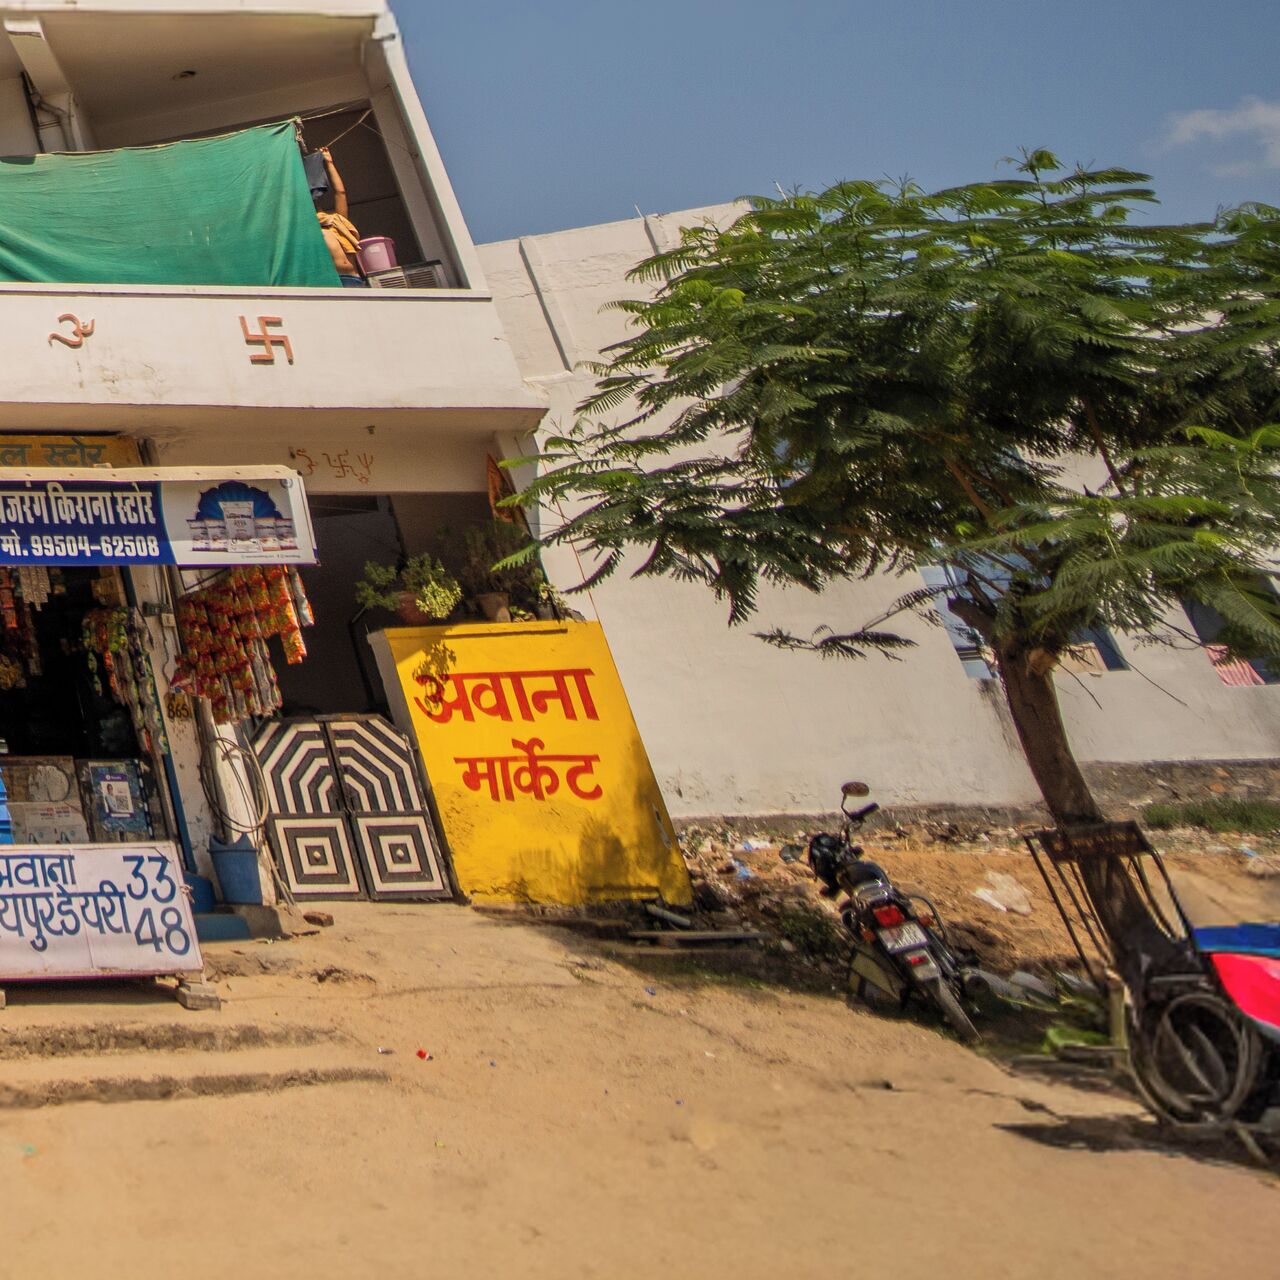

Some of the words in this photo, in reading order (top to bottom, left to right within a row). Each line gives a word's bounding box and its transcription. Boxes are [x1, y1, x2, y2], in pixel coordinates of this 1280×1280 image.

[41, 436, 107, 466] स्टोर
[48, 482, 112, 525] किराना
[111, 483, 156, 525] स्टोर
[0, 530, 28, 557] मो.
[32, 534, 159, 558] 99504-62508
[167, 703, 190, 720] 865
[413, 668, 601, 724] अवाना
[454, 737, 603, 802] मार्केट
[123, 855, 177, 904] 33
[134, 907, 191, 956] 48
